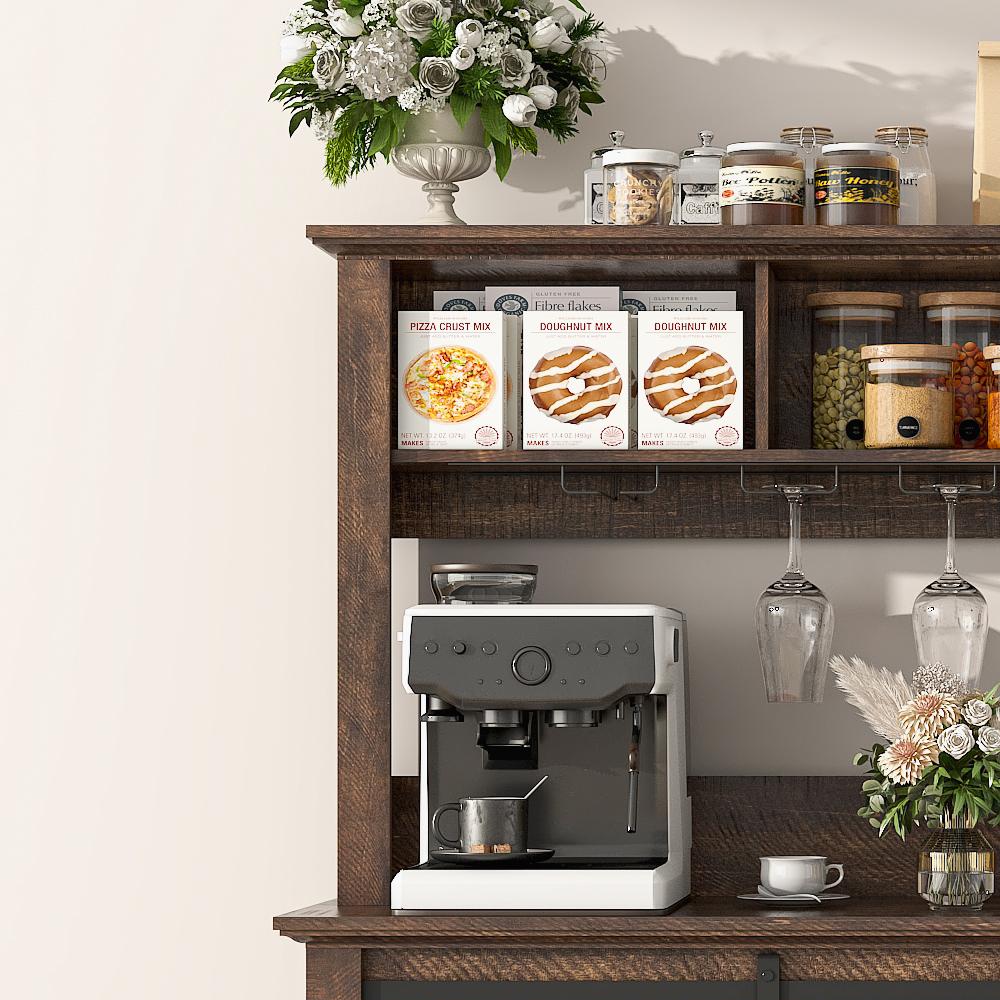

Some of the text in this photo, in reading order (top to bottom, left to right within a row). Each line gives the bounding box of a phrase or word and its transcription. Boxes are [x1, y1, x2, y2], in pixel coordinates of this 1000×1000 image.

[745, 176, 797, 186] Pollen
[844, 176, 895, 189] Honey
[534, 299, 602, 311] Fibre flakes
[410, 322, 491, 331] PIZZA CRUST MIX
[539, 322, 613, 331] DOUGHNUT MIX
[654, 322, 727, 331] DOUGHNUT MIX
